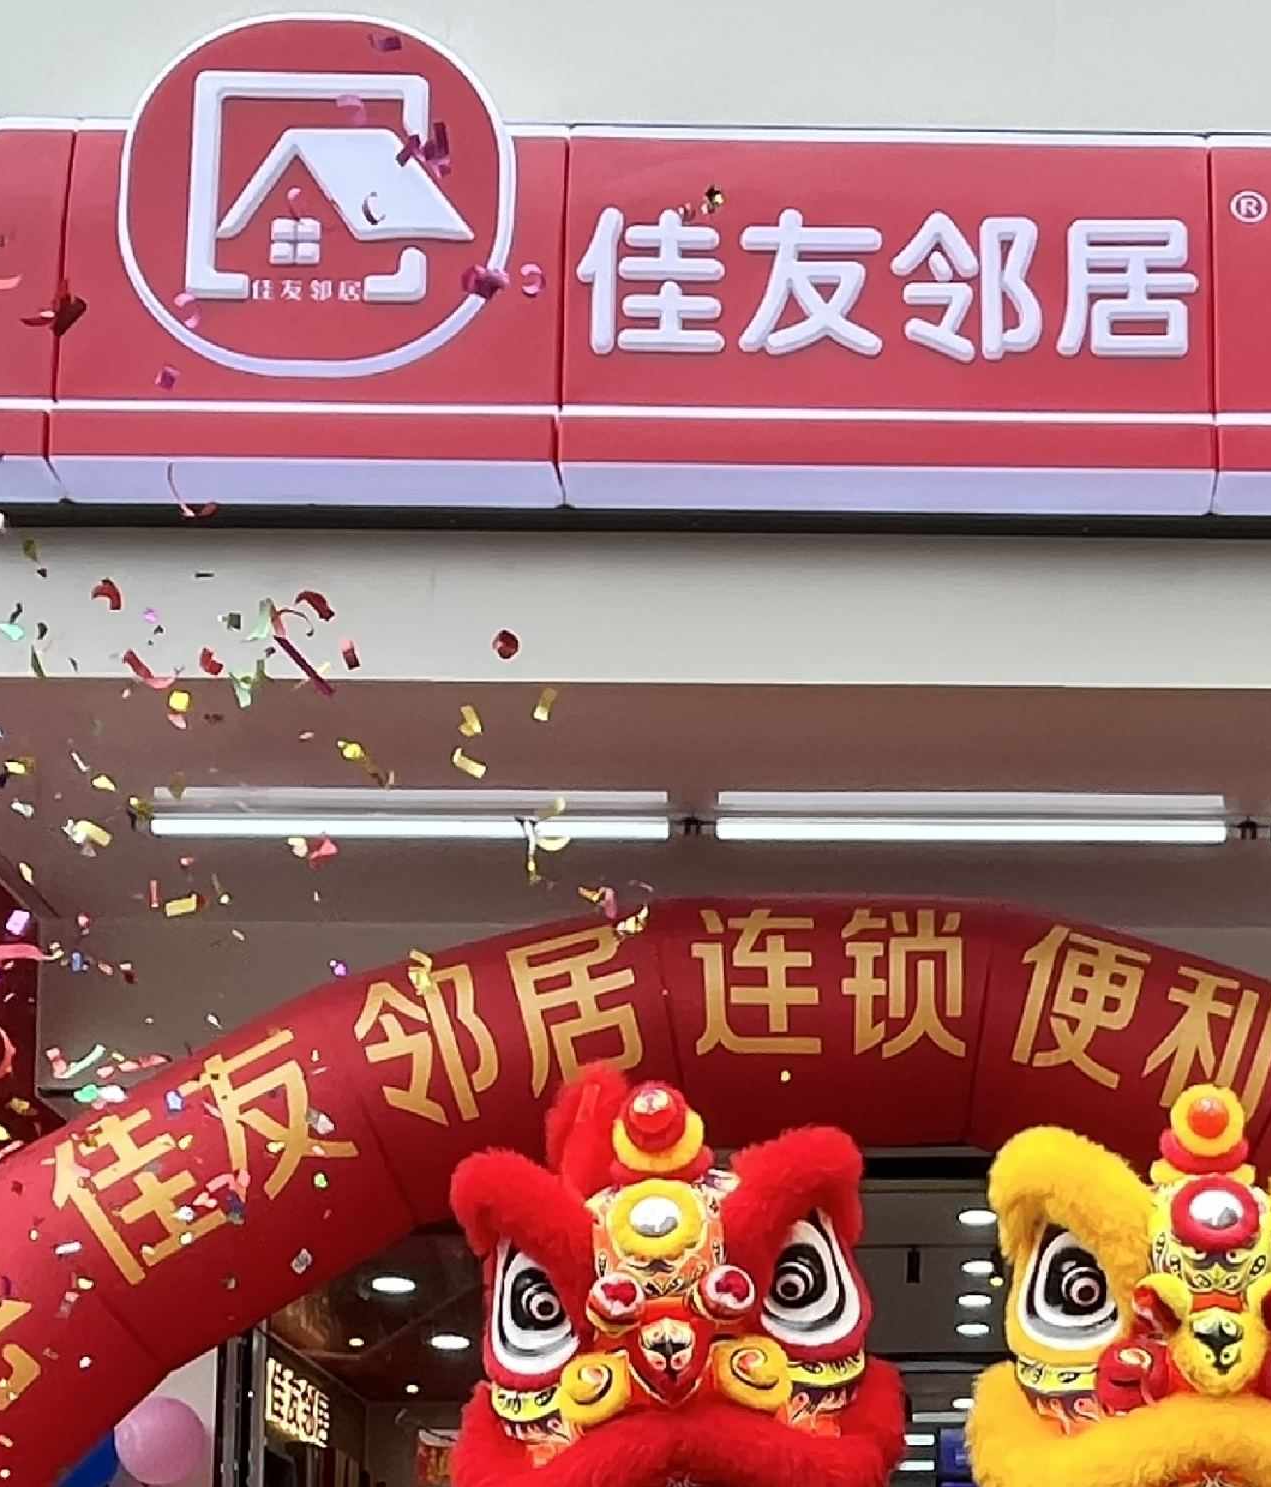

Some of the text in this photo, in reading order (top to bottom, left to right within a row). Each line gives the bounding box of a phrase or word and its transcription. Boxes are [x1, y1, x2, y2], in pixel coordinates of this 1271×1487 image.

[251, 279, 362, 301] 佳友邻居
[576, 206, 1200, 361] 佳友邻居
